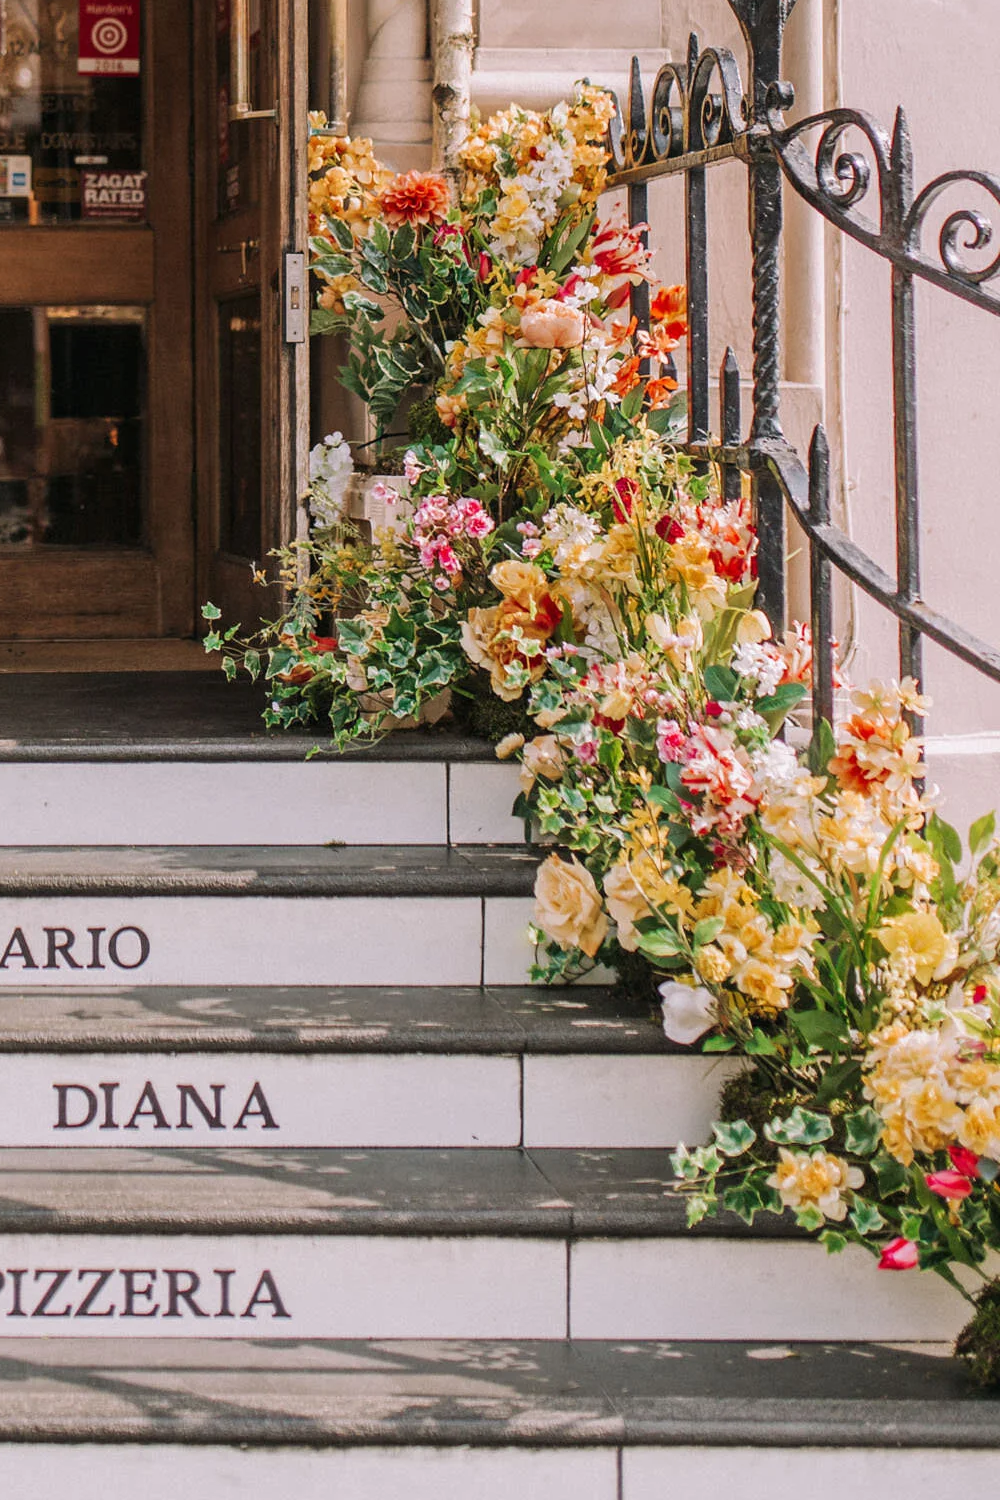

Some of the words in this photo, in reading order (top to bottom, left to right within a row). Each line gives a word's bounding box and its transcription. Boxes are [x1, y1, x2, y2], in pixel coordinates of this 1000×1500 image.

[84, 173, 144, 189] ZAGAT
[84, 190, 145, 204] RATED
[52, 1080, 280, 1130] DIANA
